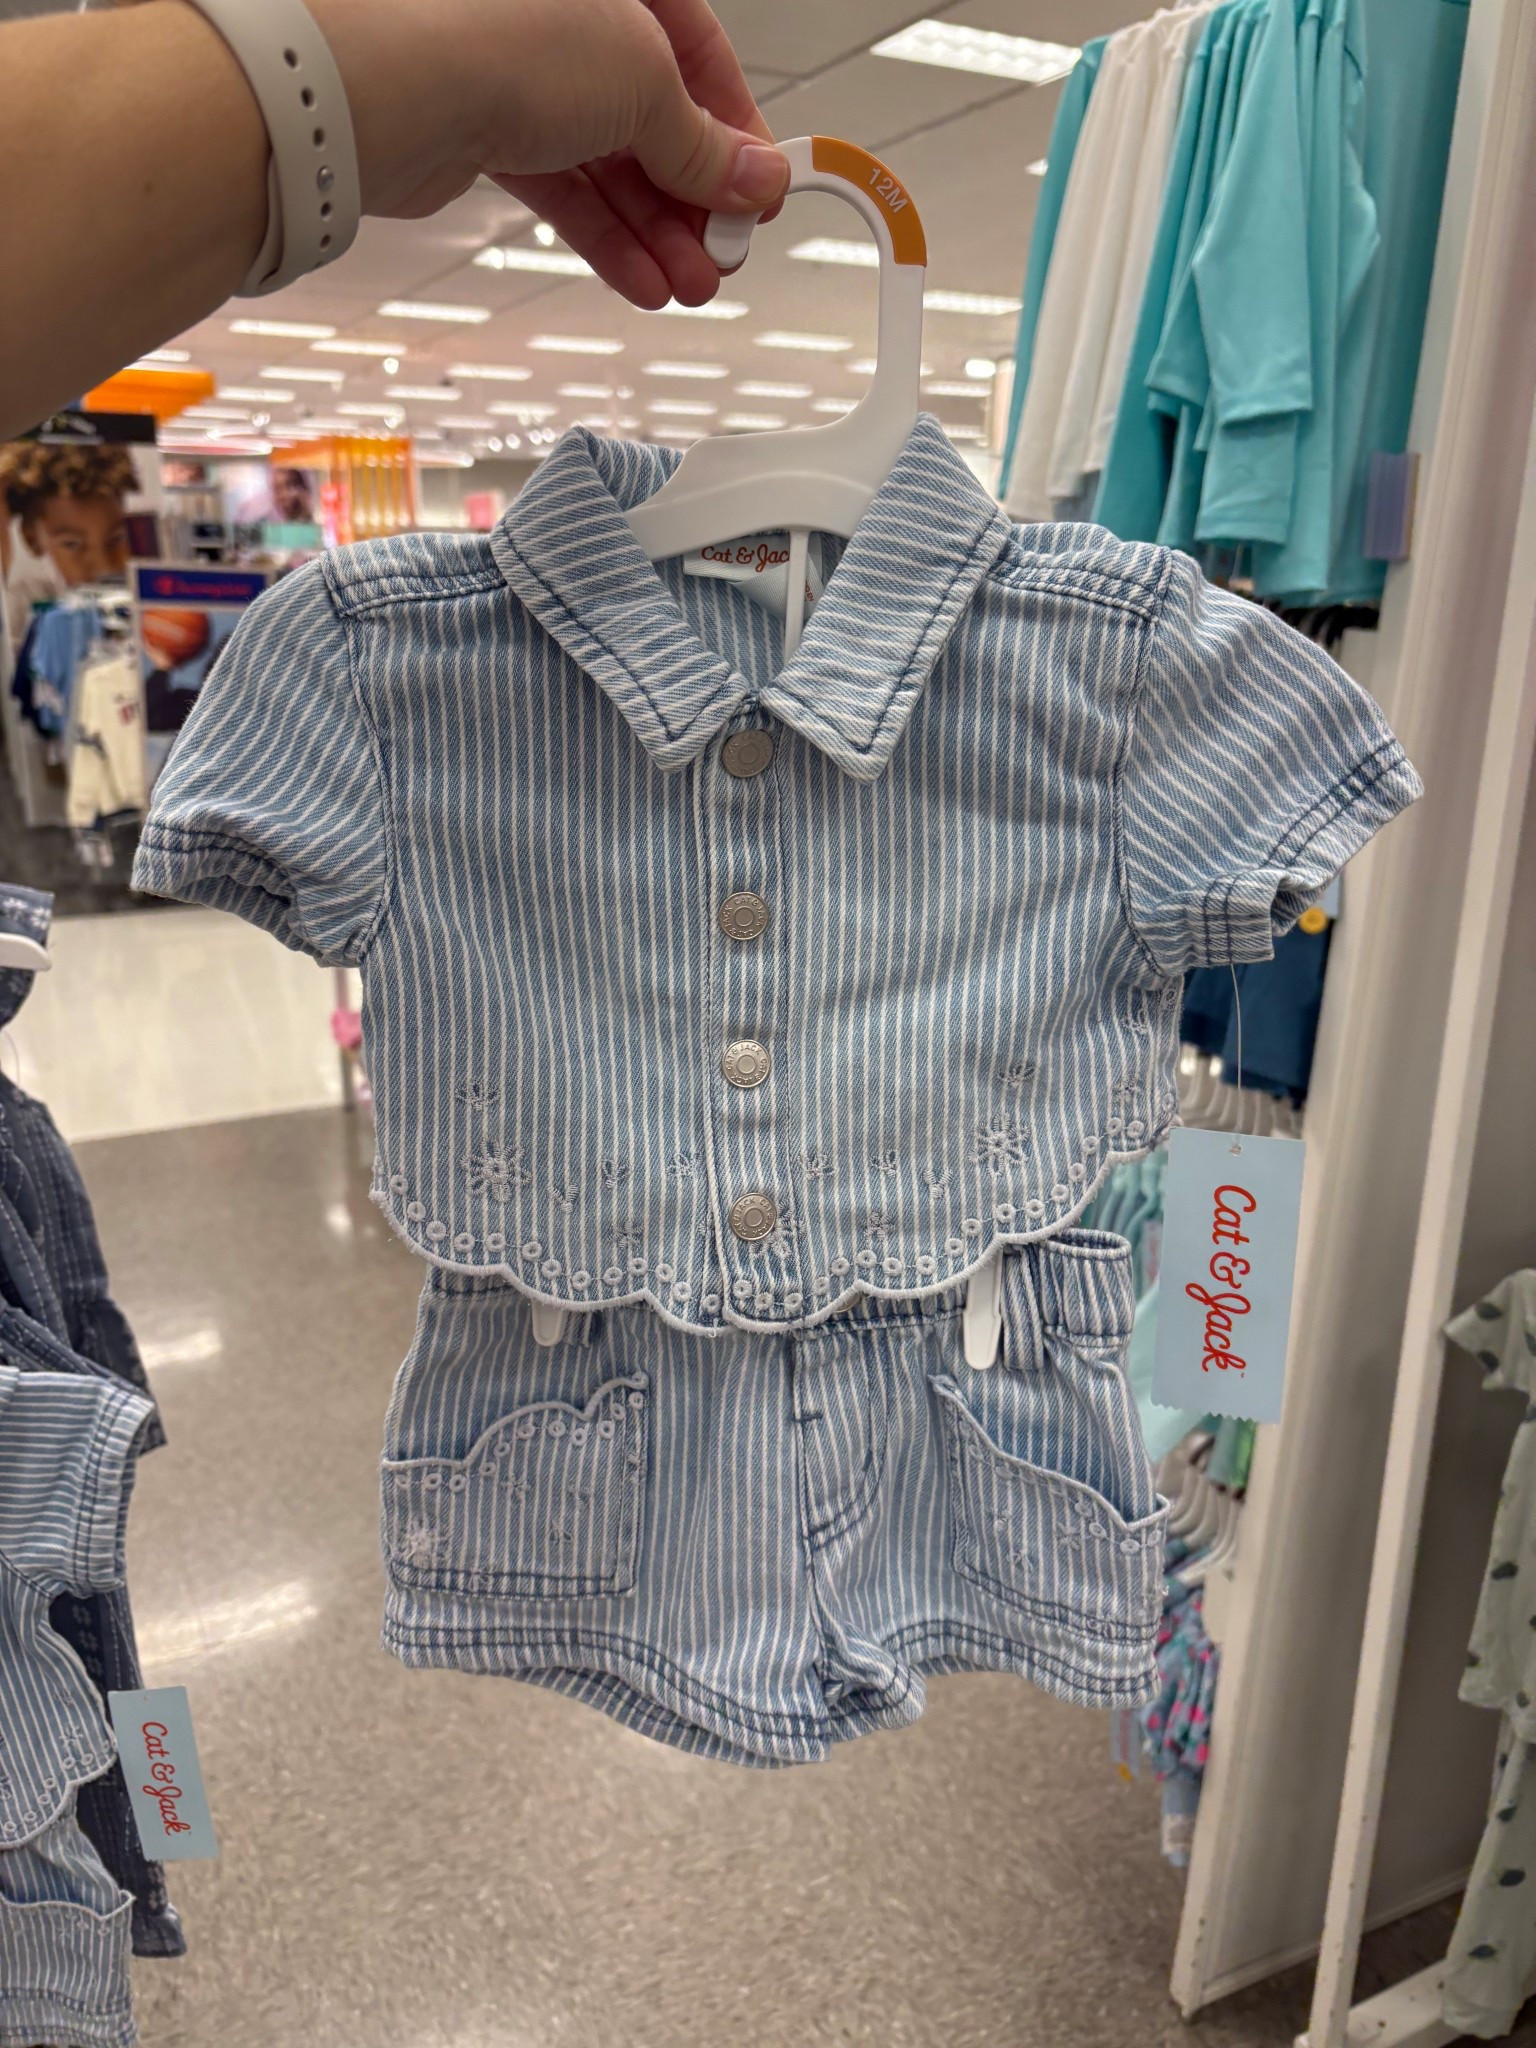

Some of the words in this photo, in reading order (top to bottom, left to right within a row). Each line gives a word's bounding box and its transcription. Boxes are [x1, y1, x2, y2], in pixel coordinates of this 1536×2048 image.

[868, 167, 909, 214] 12M
[701, 546, 734, 564] Cat
[736, 547, 755, 564] &
[755, 544, 791, 573] Jac
[733, 895, 751, 905] CAT
[723, 904, 733, 928] JACK
[725, 1055, 735, 1071] CAT
[740, 1044, 763, 1056] JACK
[736, 1196, 756, 1214] JACK
[759, 1198, 772, 1212] CAT
[1212, 1184, 1257, 1245] Cat
[1209, 1251, 1251, 1290] &
[1184, 1282, 1252, 1373] Jack
[142, 1721, 169, 1760] Cat
[151, 1762, 176, 1784] &
[142, 1785, 191, 1837] Jack
